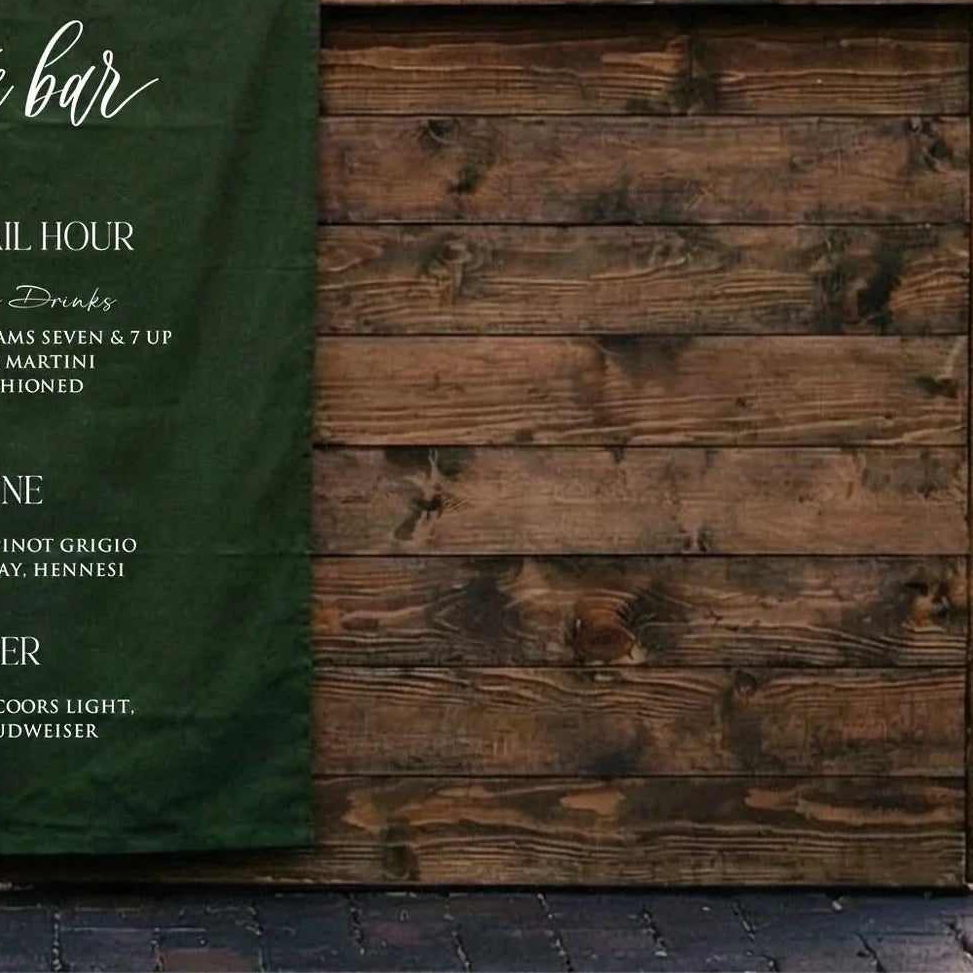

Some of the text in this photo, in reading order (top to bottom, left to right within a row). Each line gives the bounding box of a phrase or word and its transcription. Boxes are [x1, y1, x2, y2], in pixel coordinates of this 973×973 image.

[24, 19, 160, 128] bar
[40, 220, 135, 252] HOUR
[7, 284, 118, 313] Drinks
[41, 329, 104, 346] SEVEN
[110, 329, 126, 346] &
[130, 329, 141, 345] 7
[145, 329, 173, 346] UP
[5, 353, 96, 370] MARTINI
[59, 537, 138, 554] GRIGIO
[33, 561, 125, 578] HENNESI
[66, 698, 135, 716] LIGHT,
